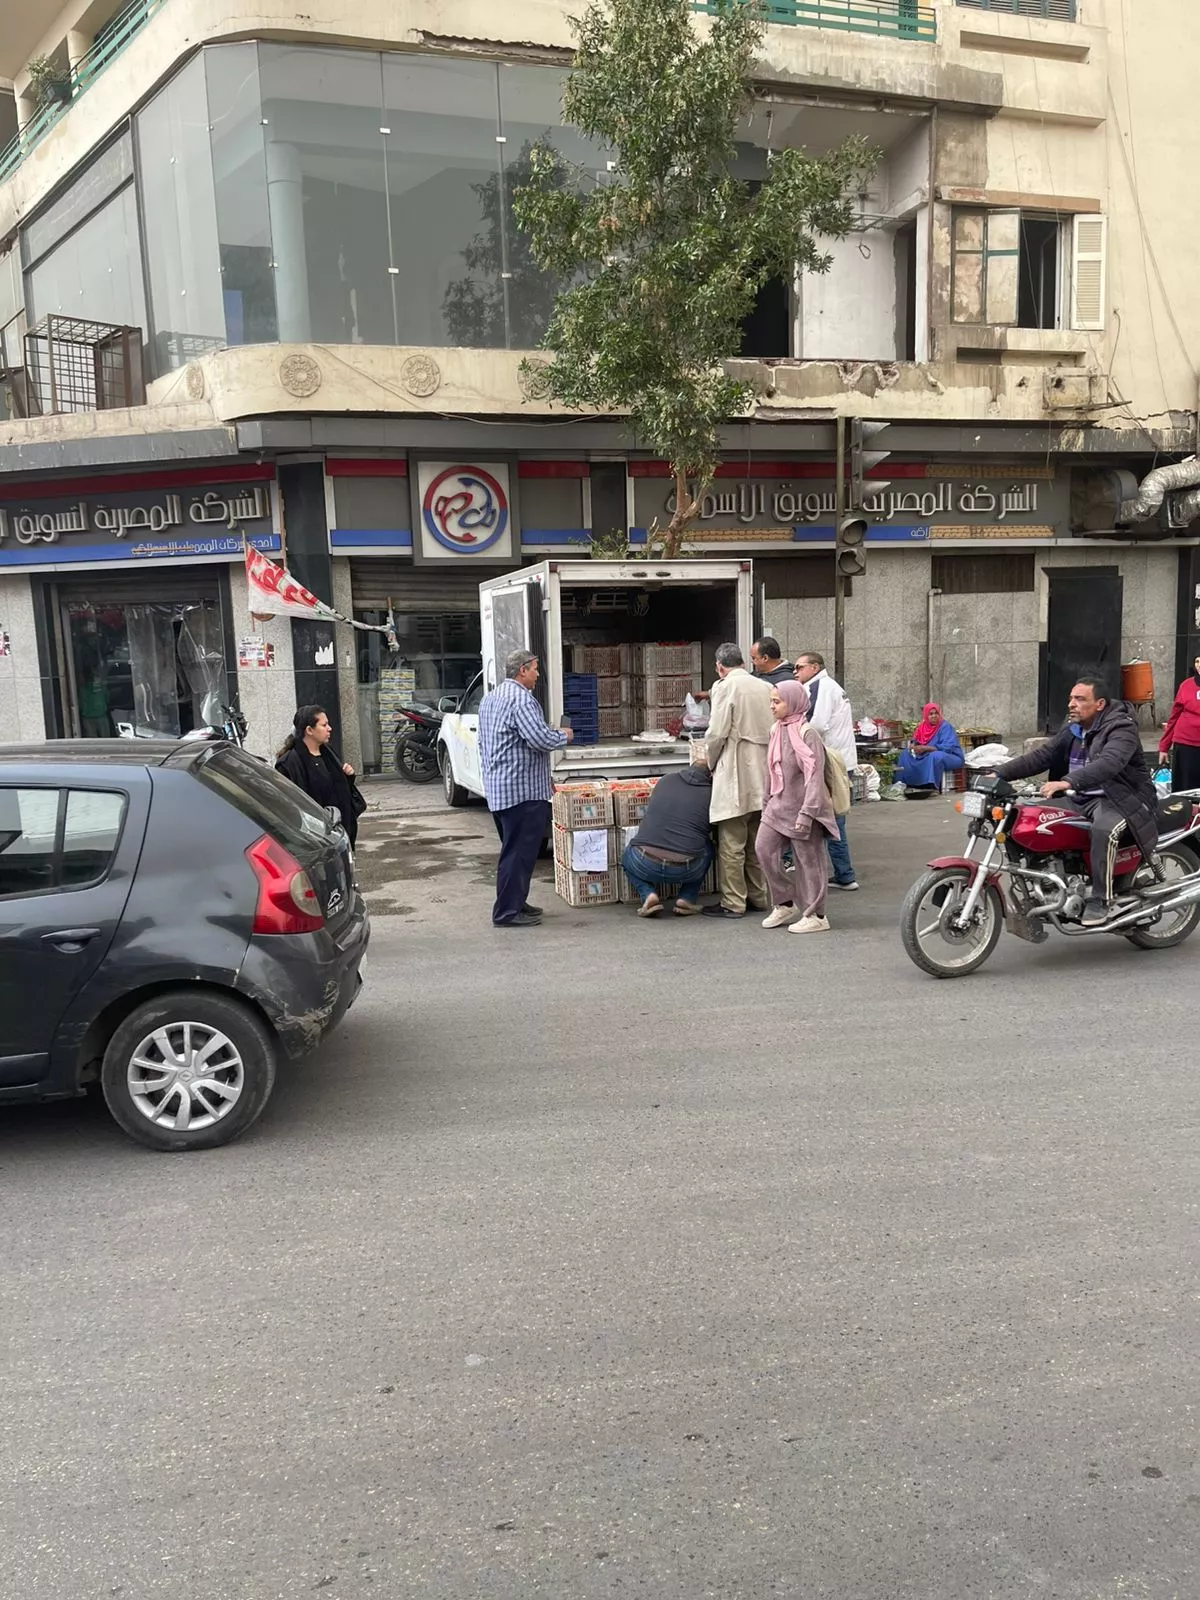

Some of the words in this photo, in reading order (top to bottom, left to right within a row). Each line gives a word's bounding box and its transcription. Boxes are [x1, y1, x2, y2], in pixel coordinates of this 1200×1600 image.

[94, 494, 183, 538] المصرية
[189, 488, 270, 530] الشركة
[666, 483, 766, 522] الاسم
[773, 483, 853, 522] لسويق
[960, 484, 1038, 520] الشركة
[13, 501, 90, 544] لتسويق
